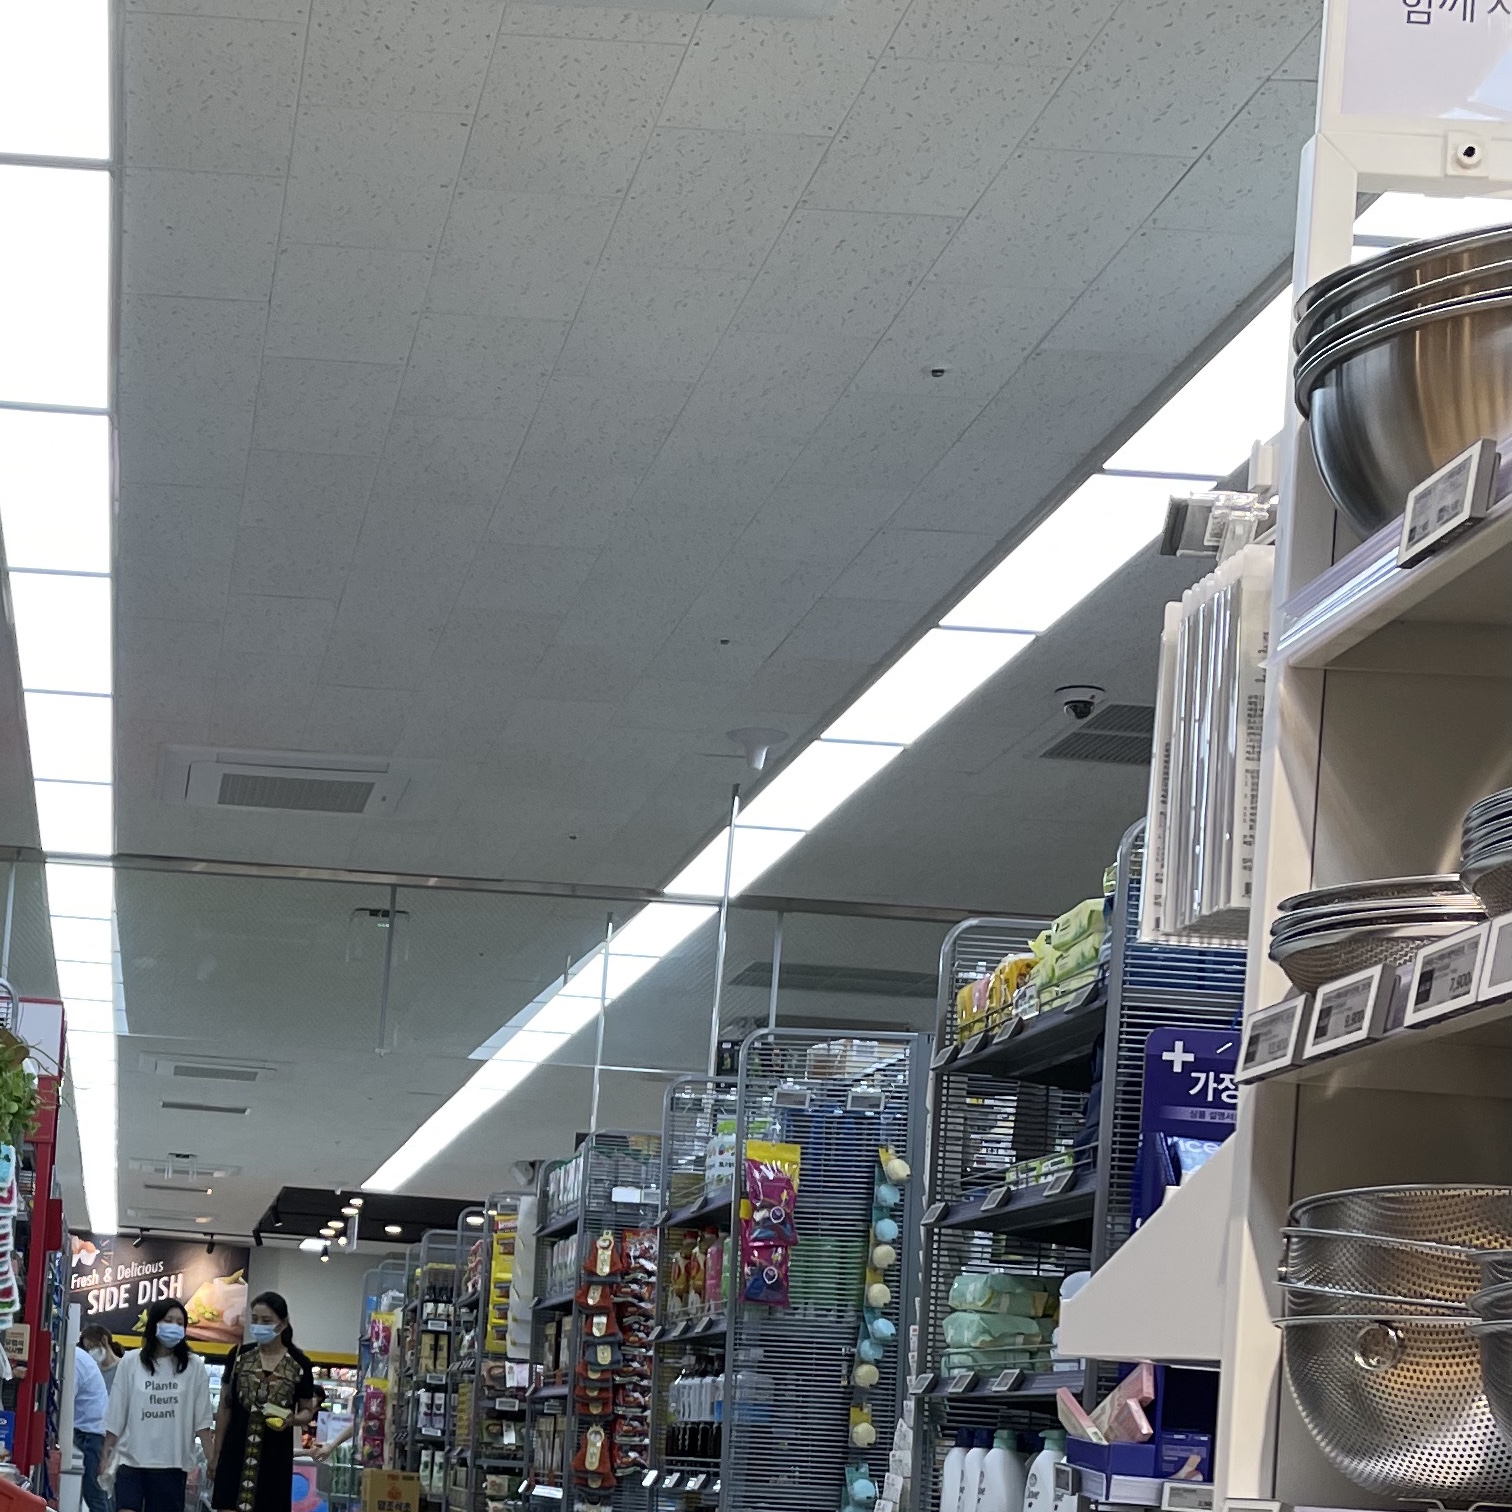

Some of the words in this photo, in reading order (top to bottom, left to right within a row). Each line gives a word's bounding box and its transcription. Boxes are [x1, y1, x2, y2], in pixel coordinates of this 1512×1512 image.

[70, 1268, 99, 1290] Fresh
[103, 1267, 112, 1283] &
[117, 1260, 164, 1281] Delicious
[87, 1283, 131, 1315] SIDE
[138, 1273, 184, 1306] DISH
[144, 1380, 178, 1391] Plante
[149, 1394, 179, 1405] fleurs
[140, 1409, 176, 1421] jouant
